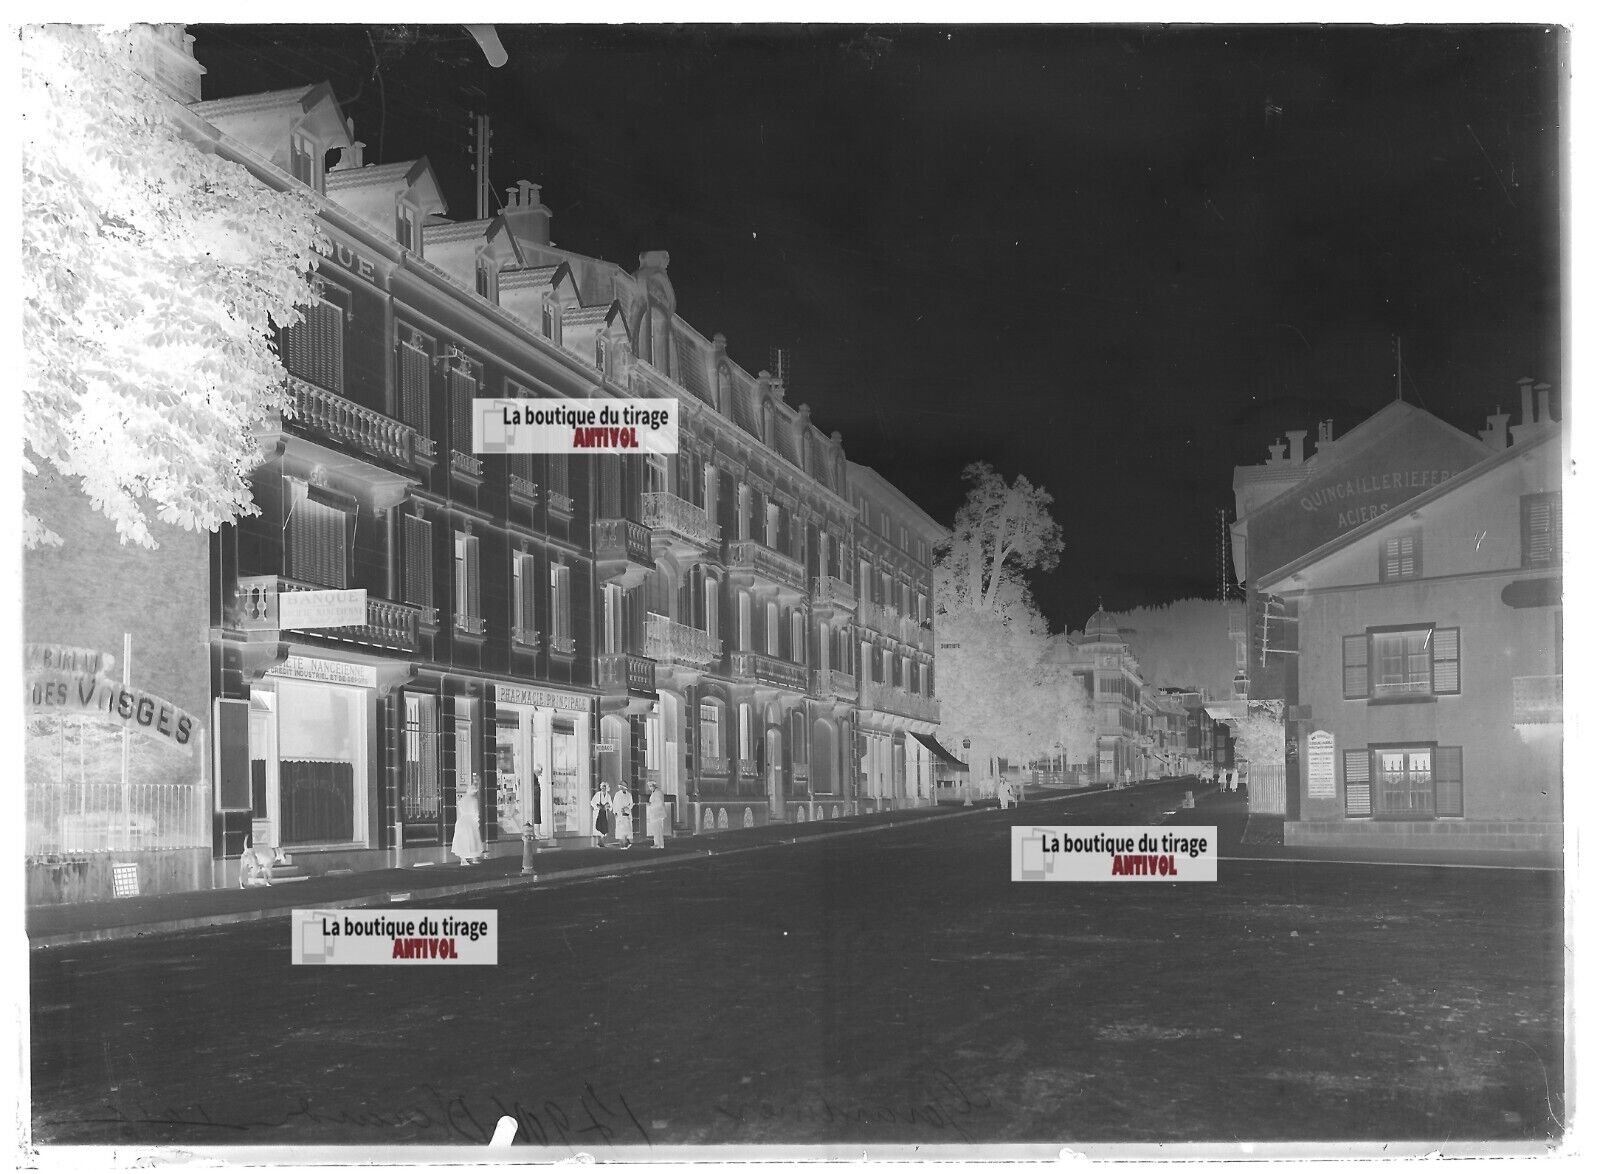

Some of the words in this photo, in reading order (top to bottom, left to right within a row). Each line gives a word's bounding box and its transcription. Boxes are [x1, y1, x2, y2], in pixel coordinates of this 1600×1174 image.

[1337, 503, 1389, 528] ACIERS
[288, 591, 359, 605] BANQUE
[501, 687, 544, 706] PHARMACIE
[76, 677, 193, 745] VOSGES
